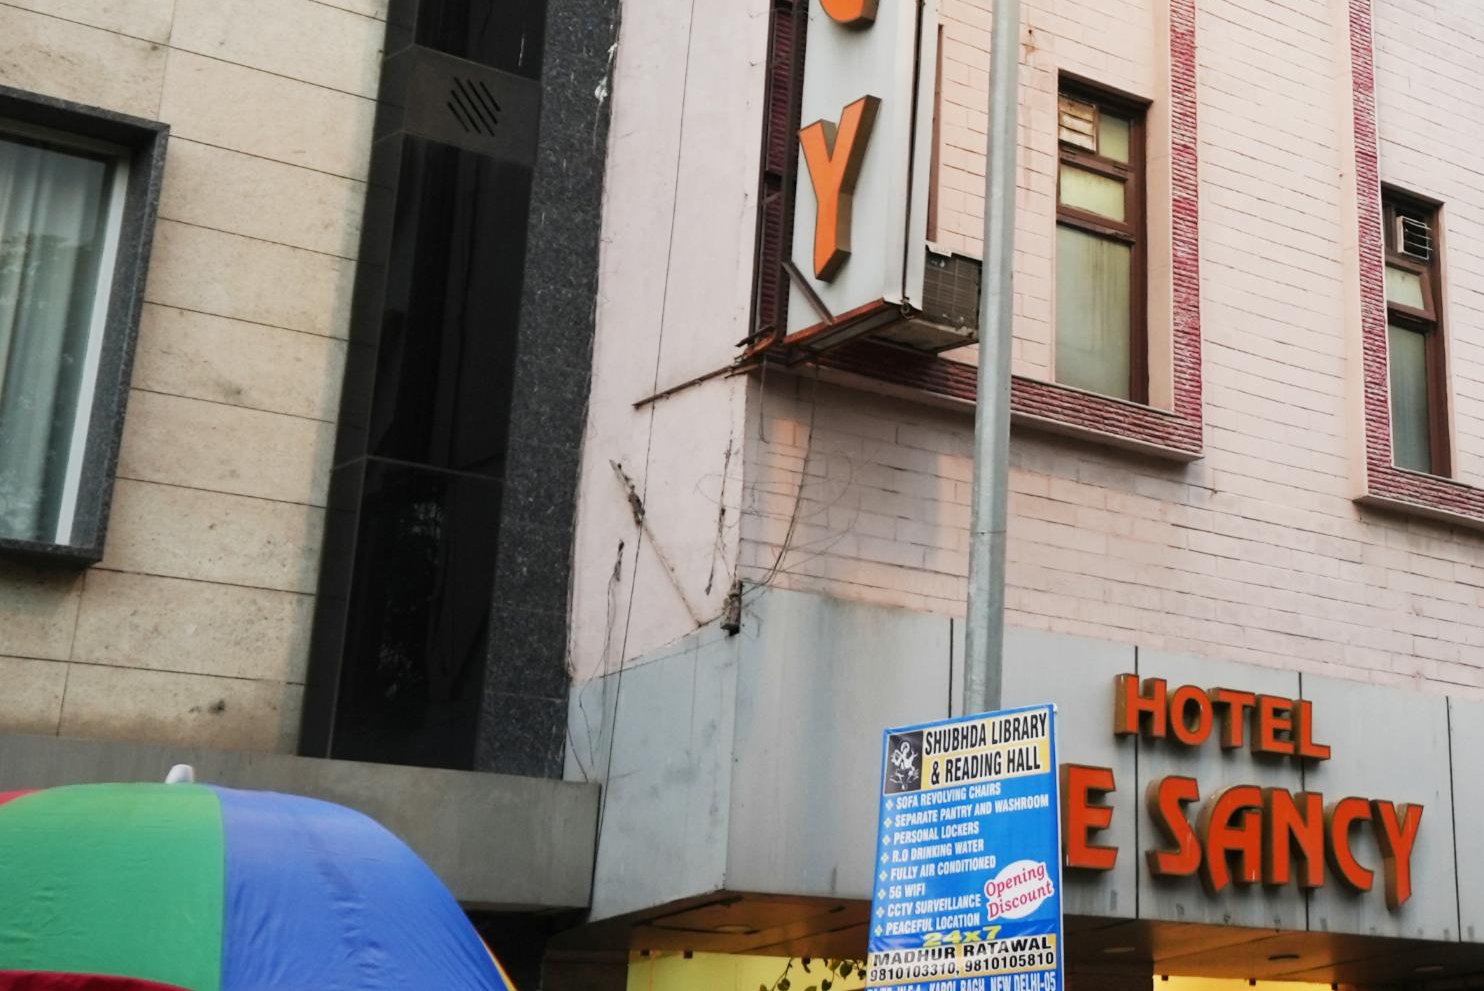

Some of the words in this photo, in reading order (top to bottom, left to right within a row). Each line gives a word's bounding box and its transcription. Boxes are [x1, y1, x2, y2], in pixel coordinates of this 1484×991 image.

[1115, 673, 1331, 761] HOTEL
[925, 721, 987, 756] SHUBHDA
[991, 712, 1047, 744] LIBRARY
[930, 761, 940, 785] &
[945, 751, 1002, 783] READING
[1007, 745, 1041, 773] HALL
[895, 810, 938, 827] SEPARATE
[940, 805, 972, 821] PANTRY
[974, 802, 992, 815] AND
[994, 794, 1049, 813] WASHROOM
[896, 797, 918, 810] SOFA
[920, 788, 966, 807] REVOLVING
[969, 783, 1001, 799] CHAIRS
[894, 828, 938, 845] PERSONAL
[941, 821, 979, 838] LOCKERS
[1060, 762, 1119, 870] E
[1146, 775, 1424, 909] SANCY
[910, 842, 952, 859] DRINKING
[955, 839, 984, 854] WATER
[890, 864, 918, 881] FULLY
[920, 862, 935, 877] AIR
[937, 856, 996, 875] CONDITIONED
[985, 864, 1046, 897] Opening
[888, 903, 913, 917] CCTV
[915, 894, 981, 914] SURVEILLANCE
[889, 885, 902, 899] 5G
[905, 883, 925, 897] WIFI
[988, 881, 1053, 919] Discount
[885, 918, 933, 935] PEACEFUL
[936, 913, 980, 929] LOCATION
[873, 946, 955, 966] MADHUR
[963, 937, 1051, 957] RATAWAL
[870, 961, 960, 982] 9810103310,
[965, 952, 1054, 972] 9810105810
